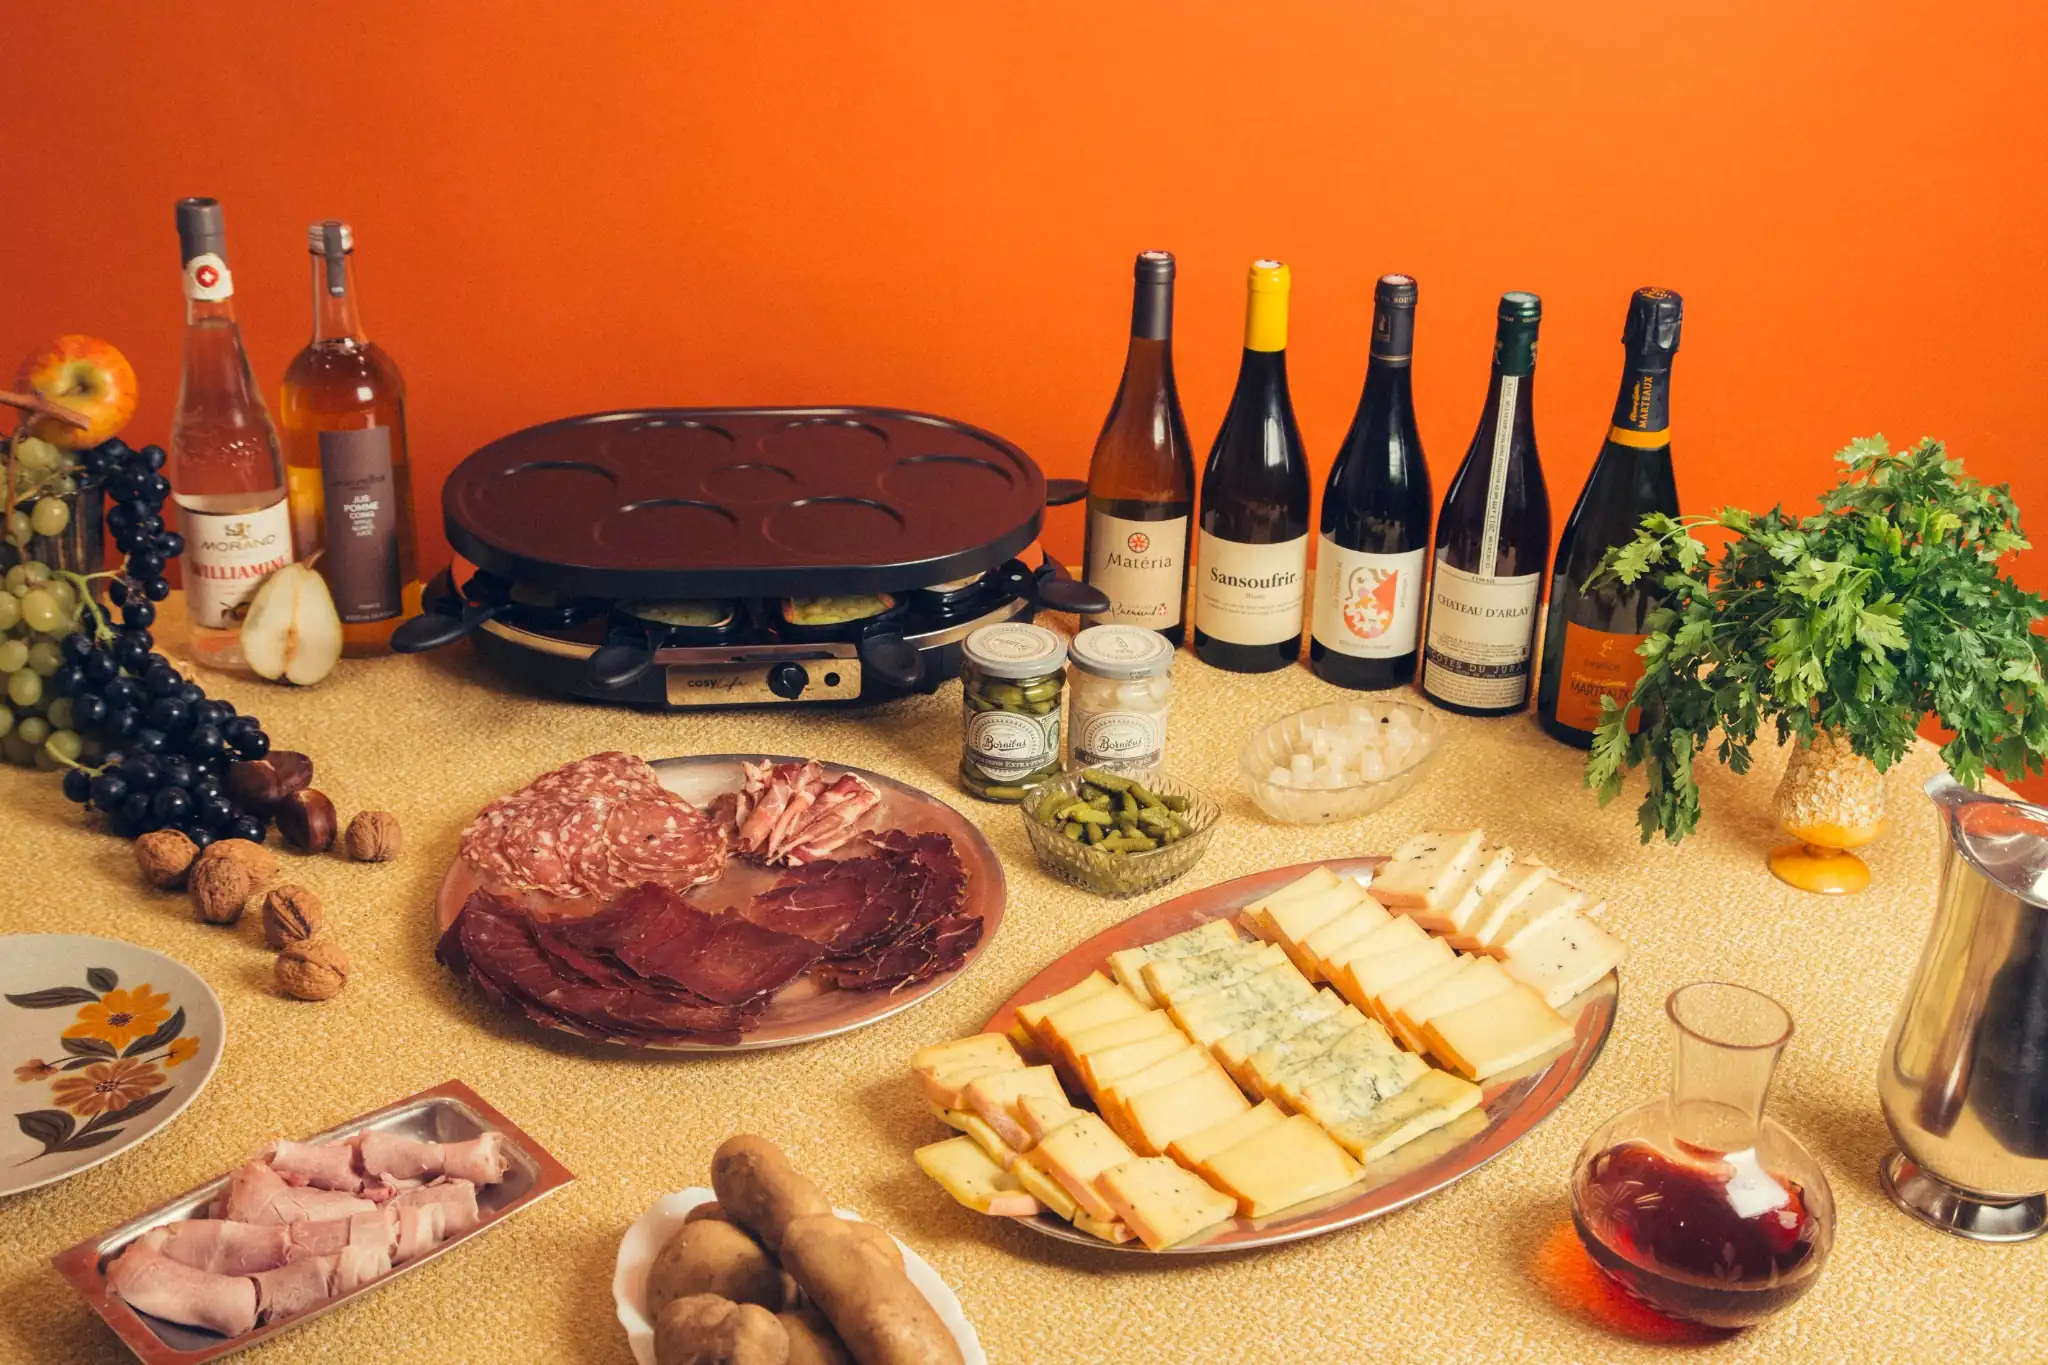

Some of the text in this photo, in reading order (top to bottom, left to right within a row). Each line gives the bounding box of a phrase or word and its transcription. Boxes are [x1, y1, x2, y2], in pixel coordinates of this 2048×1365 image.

[1638, 376, 1653, 428] MARTEAUX
[343, 501, 380, 513] POMME
[1487, 514, 1496, 532] 2013
[201, 534, 277, 552] MORAND
[1103, 552, 1173, 570] Matéria
[1486, 605, 1531, 619] D'ARLAY
